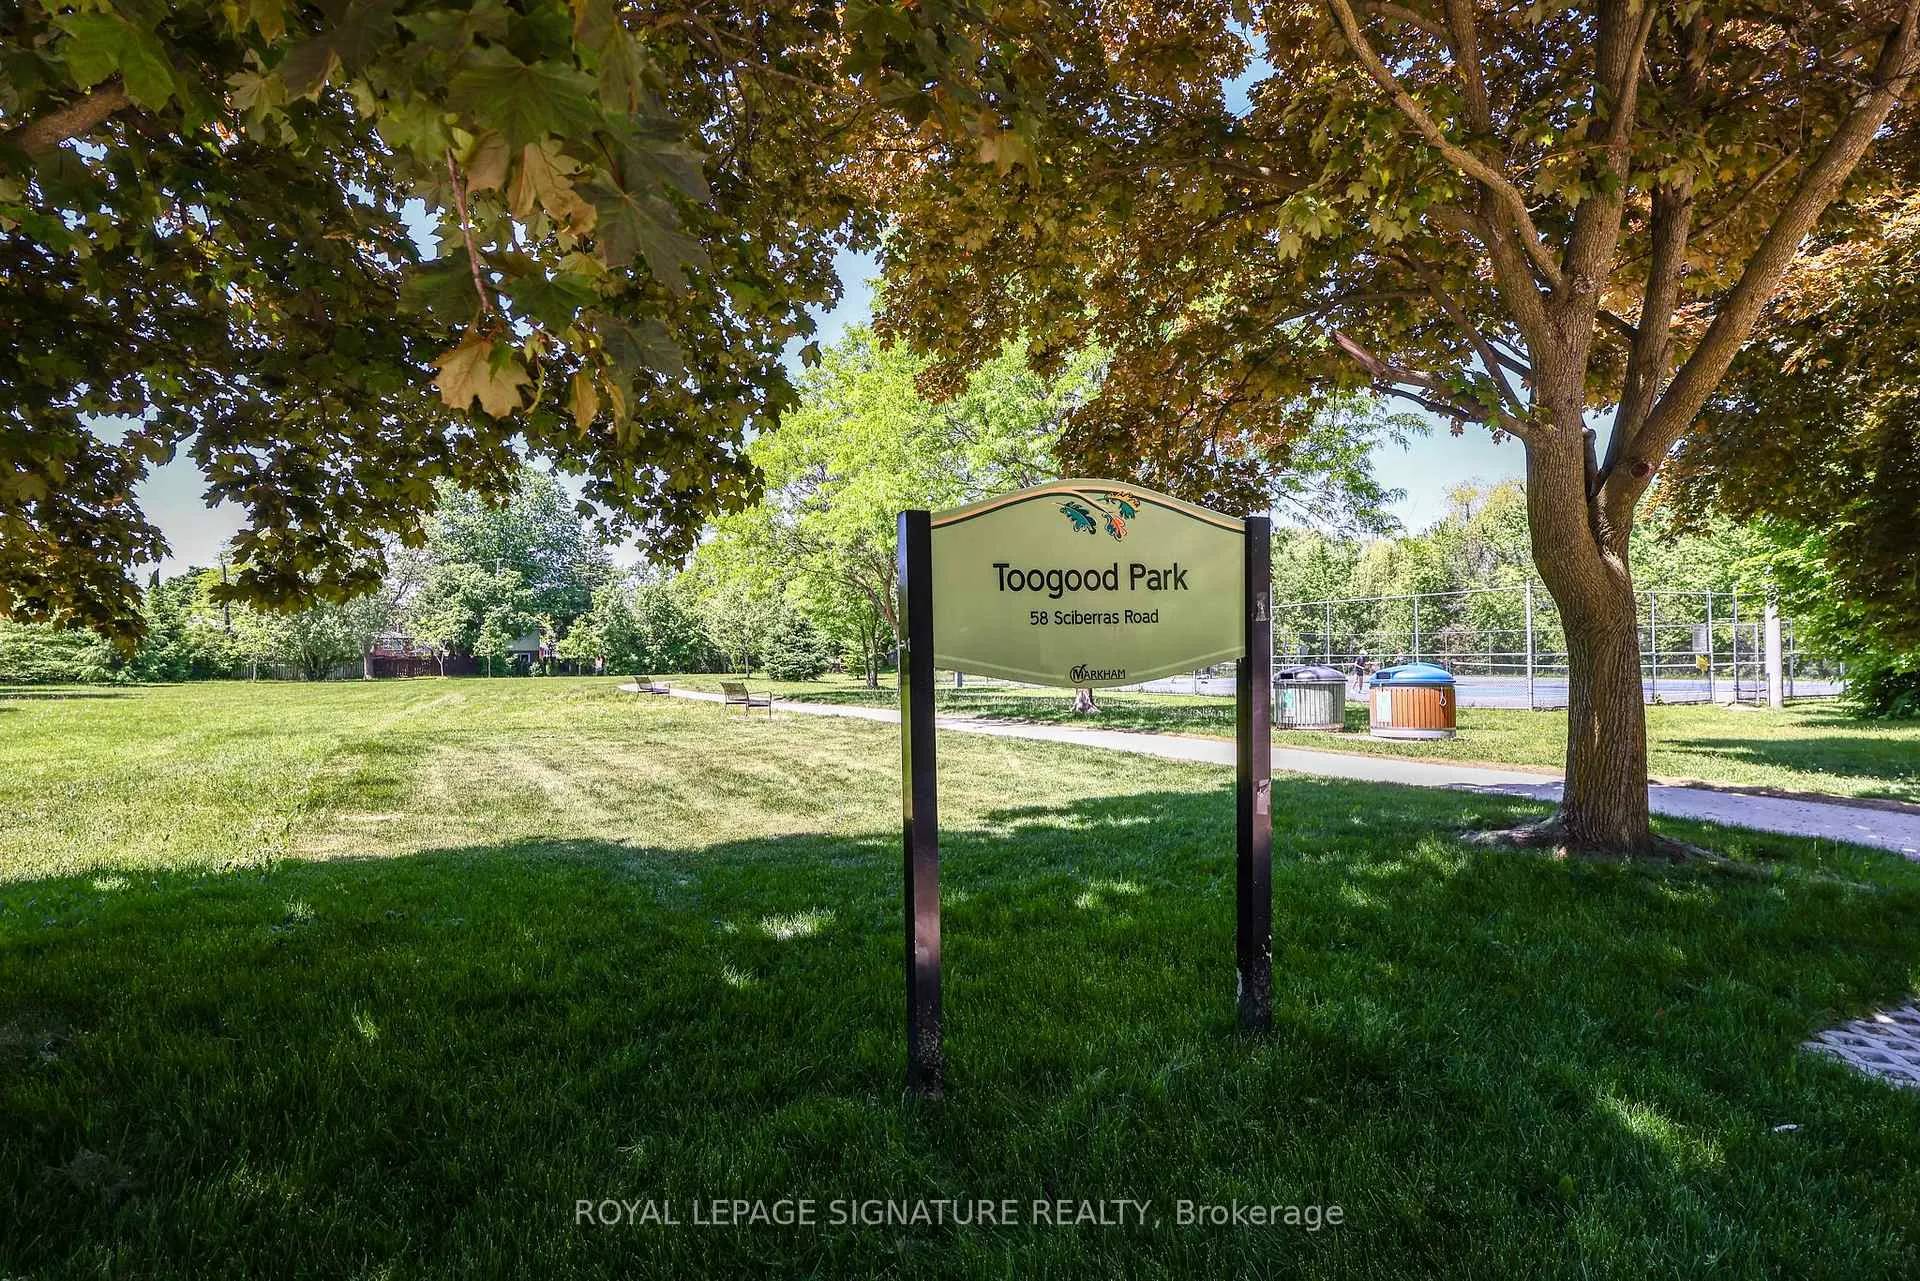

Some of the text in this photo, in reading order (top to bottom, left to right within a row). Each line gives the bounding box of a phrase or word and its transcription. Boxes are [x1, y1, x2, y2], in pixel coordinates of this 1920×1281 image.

[993, 562, 1189, 599] Toogood Park
[1029, 608, 1159, 626] 58 Sciberras Road
[1070, 664, 1126, 683] MARKHAM
